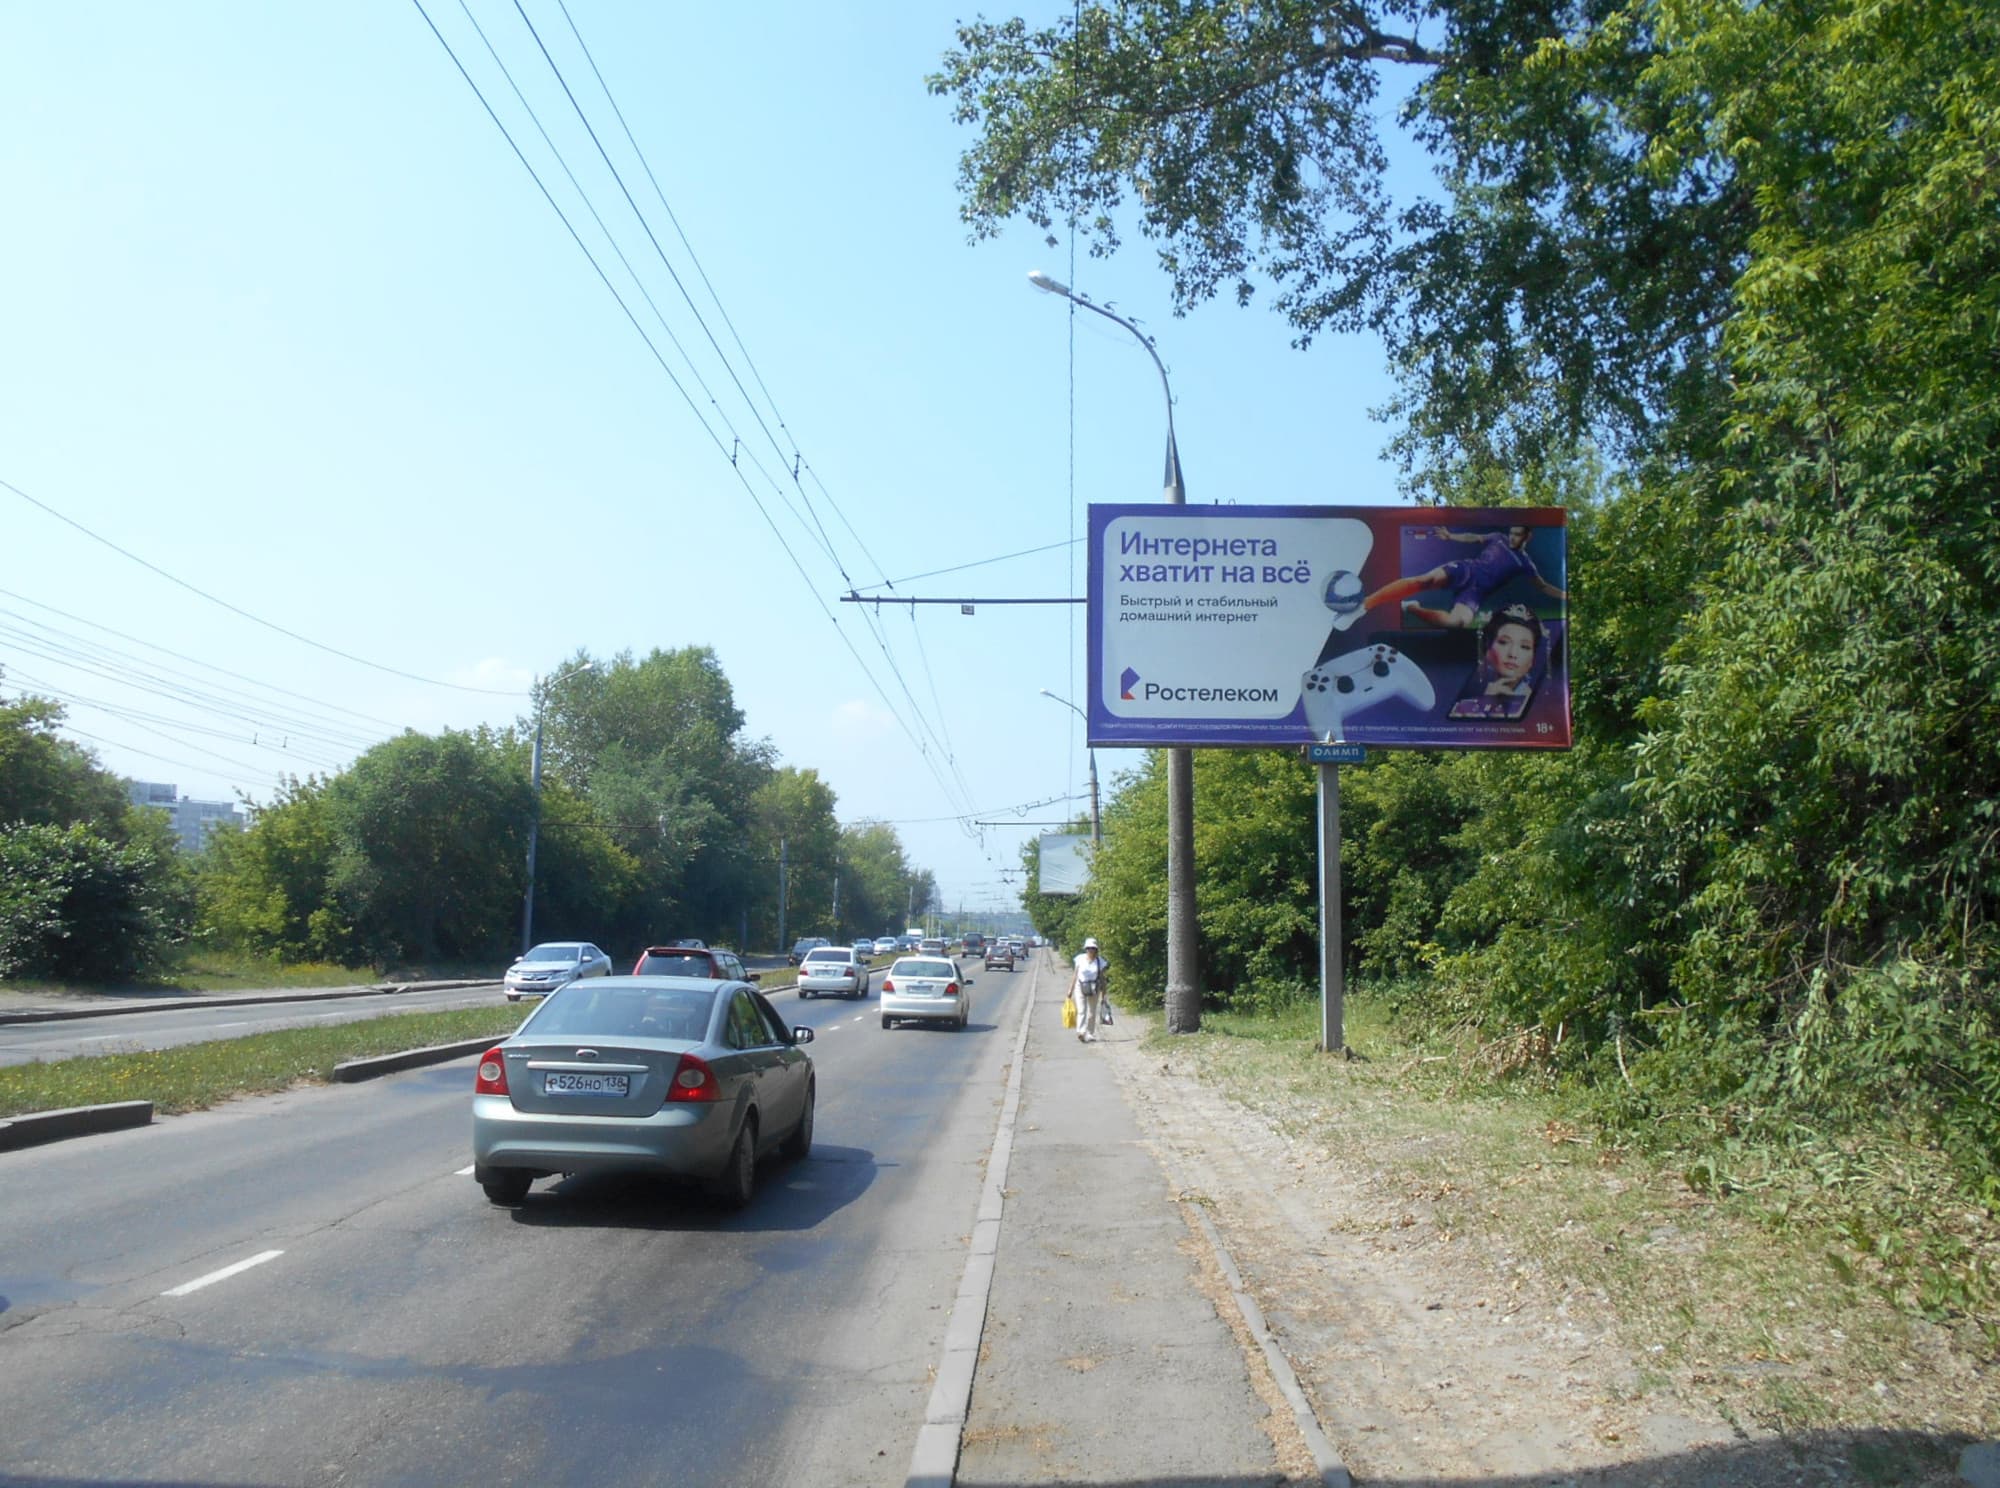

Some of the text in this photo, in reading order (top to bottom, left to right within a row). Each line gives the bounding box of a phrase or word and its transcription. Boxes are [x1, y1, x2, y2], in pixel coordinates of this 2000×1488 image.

[1121, 531, 1277, 562] Интернета
[1119, 560, 1311, 584] хватит на всё
[1120, 595, 1278, 609] Быстрый и стабильный
[1119, 611, 1258, 624] домашний интернет
[1145, 683, 1278, 702] Ростелеком
[1536, 722, 1554, 733] 18+
[1313, 747, 1360, 757] ОЛИМП
